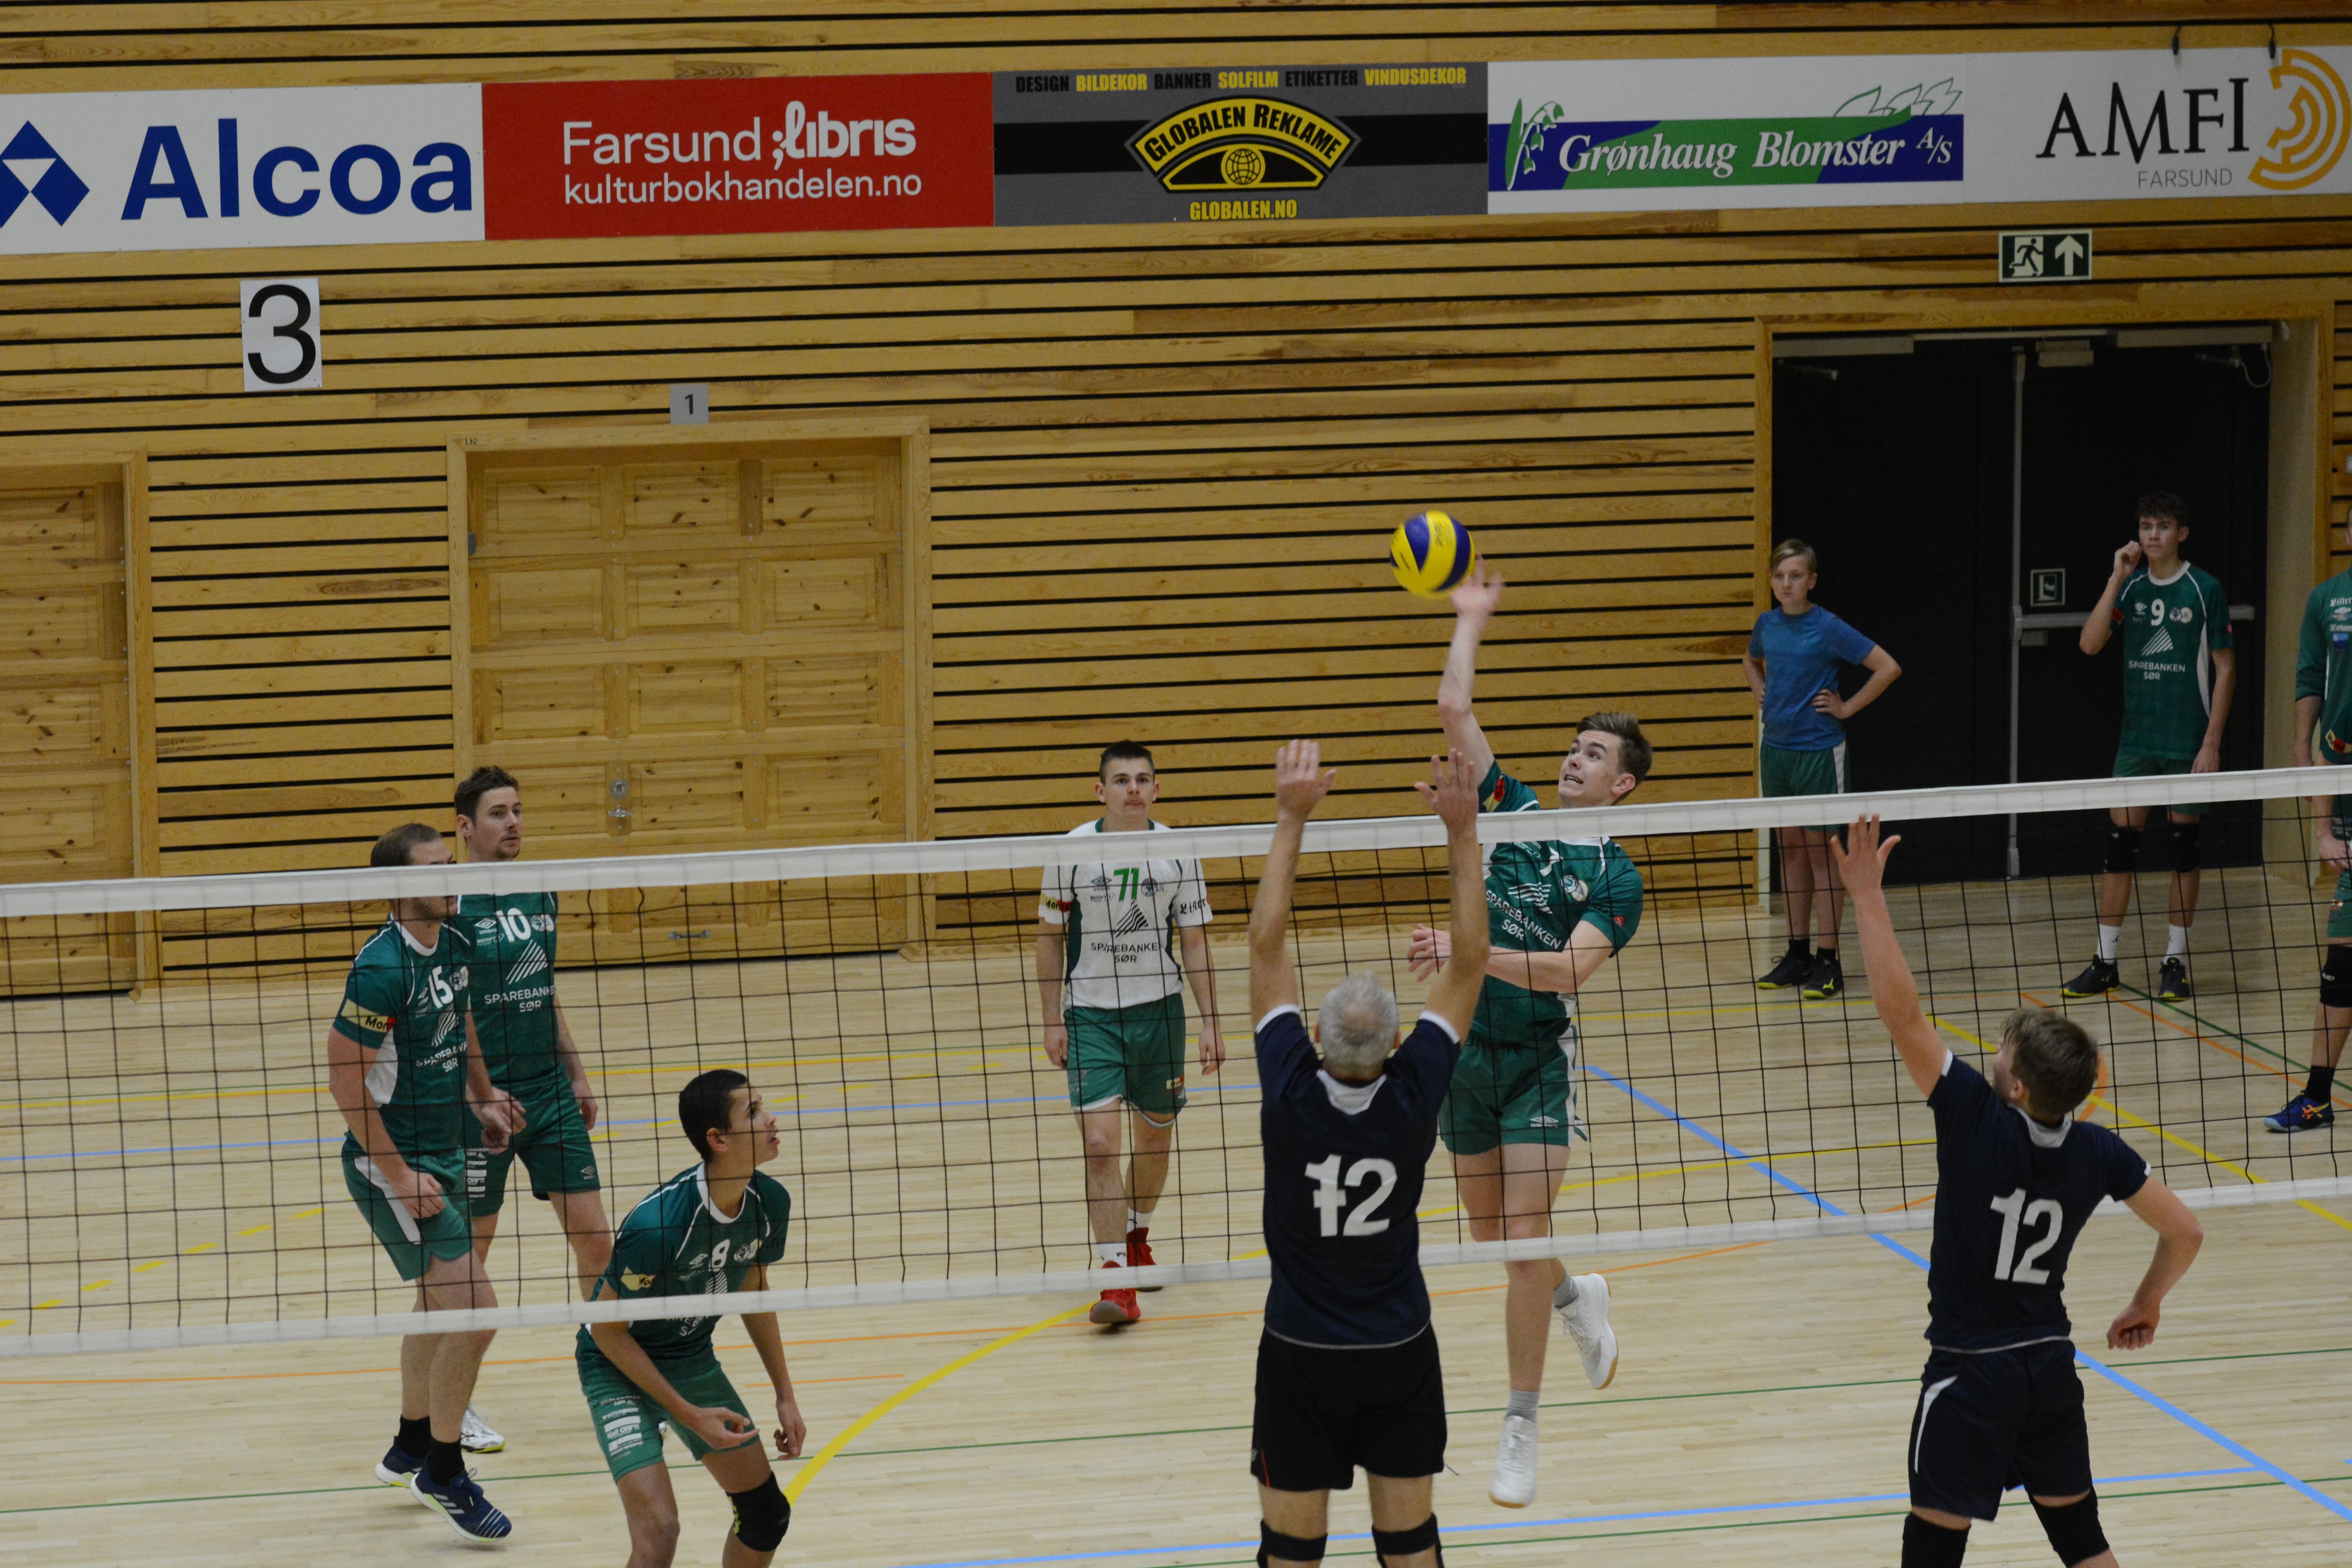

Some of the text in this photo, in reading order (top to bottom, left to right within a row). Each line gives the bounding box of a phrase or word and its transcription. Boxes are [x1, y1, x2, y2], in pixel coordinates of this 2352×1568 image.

[1016, 67, 1466, 93] DESIGN BILDEKOR BANNER SOLFILM ETIKETTER VINDUSDEKOR
[1144, 103, 1342, 162] GLOBALEN REKLAME
[2036, 78, 2250, 164] AMFI
[563, 116, 761, 165] Farsund
[1559, 133, 1738, 178] Grønhaug
[1751, 130, 1906, 169] Blomster
[122, 118, 472, 220] Alcoa
[564, 167, 922, 205] kulturbokhandelen.no
[2138, 168, 2233, 188] FARSUND
[1189, 199, 1298, 221] GLOBALEN.NO
[247, 284, 317, 385] 3
[684, 393, 694, 415] 1
[2151, 598, 2165, 626] 9
[2143, 672, 2161, 681] SØR
[1113, 867, 1140, 902] 71
[495, 907, 531, 943] 10
[427, 965, 454, 1009] 15
[1305, 1154, 1397, 1237] 12
[1990, 1187, 2063, 1285] 12
[708, 1239, 731, 1273] 8
